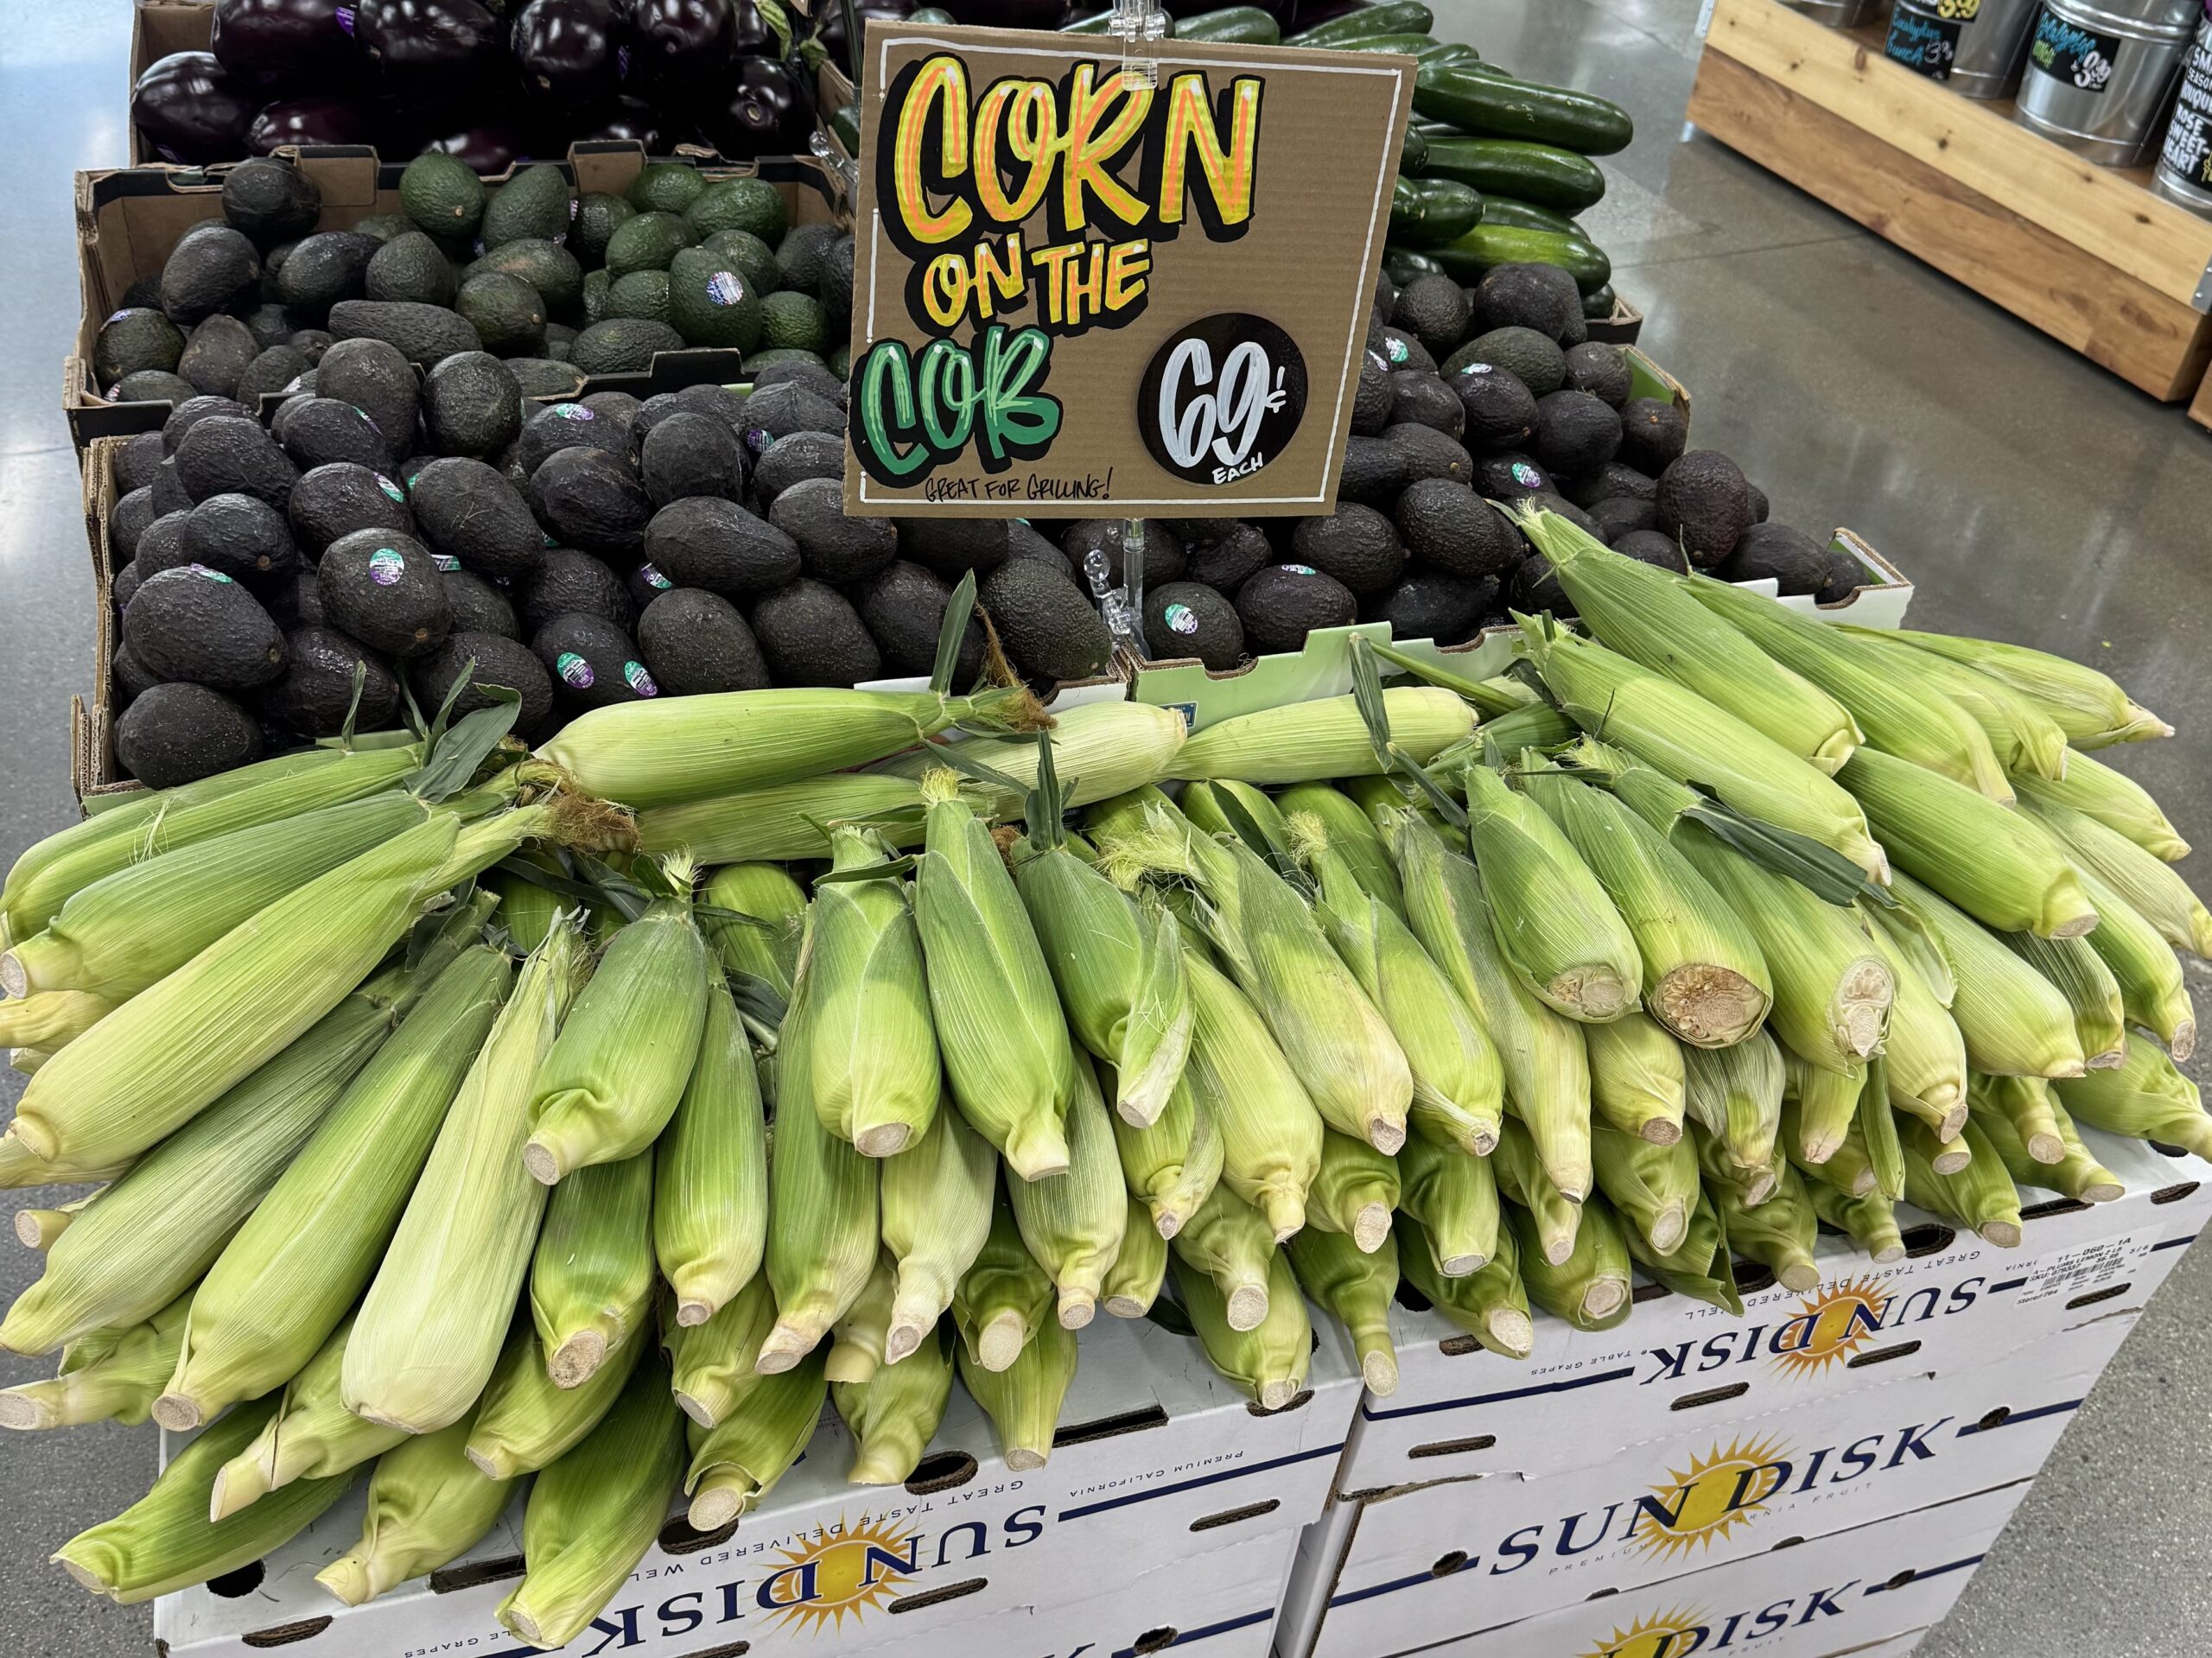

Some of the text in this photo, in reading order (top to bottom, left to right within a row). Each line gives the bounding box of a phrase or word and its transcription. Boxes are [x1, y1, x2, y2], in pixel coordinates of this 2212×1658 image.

[881, 54, 1264, 252] CORN
[912, 230, 1152, 331] ON THE
[855, 325, 1065, 480] COB
[925, 466, 1114, 503] GREAT FOR GRILLING!
[1211, 451, 1264, 485] EACH
[1862, 1265, 1914, 1284] TASTE
[1923, 1250, 1980, 1270] GREAT
[1639, 1276, 1986, 1386] SUN DISK
[1685, 1305, 1726, 1320] ELL
[1530, 1350, 1631, 1375] TABLE GRAPES
[1069, 1450, 1244, 1497] PREMIUM CALIFORNIA
[1488, 1415, 1955, 1576] SUN DISK
[628, 1479, 1024, 1582] GREAT TASTE DELIVERED WEL
[1548, 1482, 1873, 1576] PREMIUM CALIFORNIA FRUIT
[582, 1504, 1046, 1658] SUN DISK
[1650, 1579, 1862, 1658] DISK
[404, 1637, 479, 1658] GRAPES
